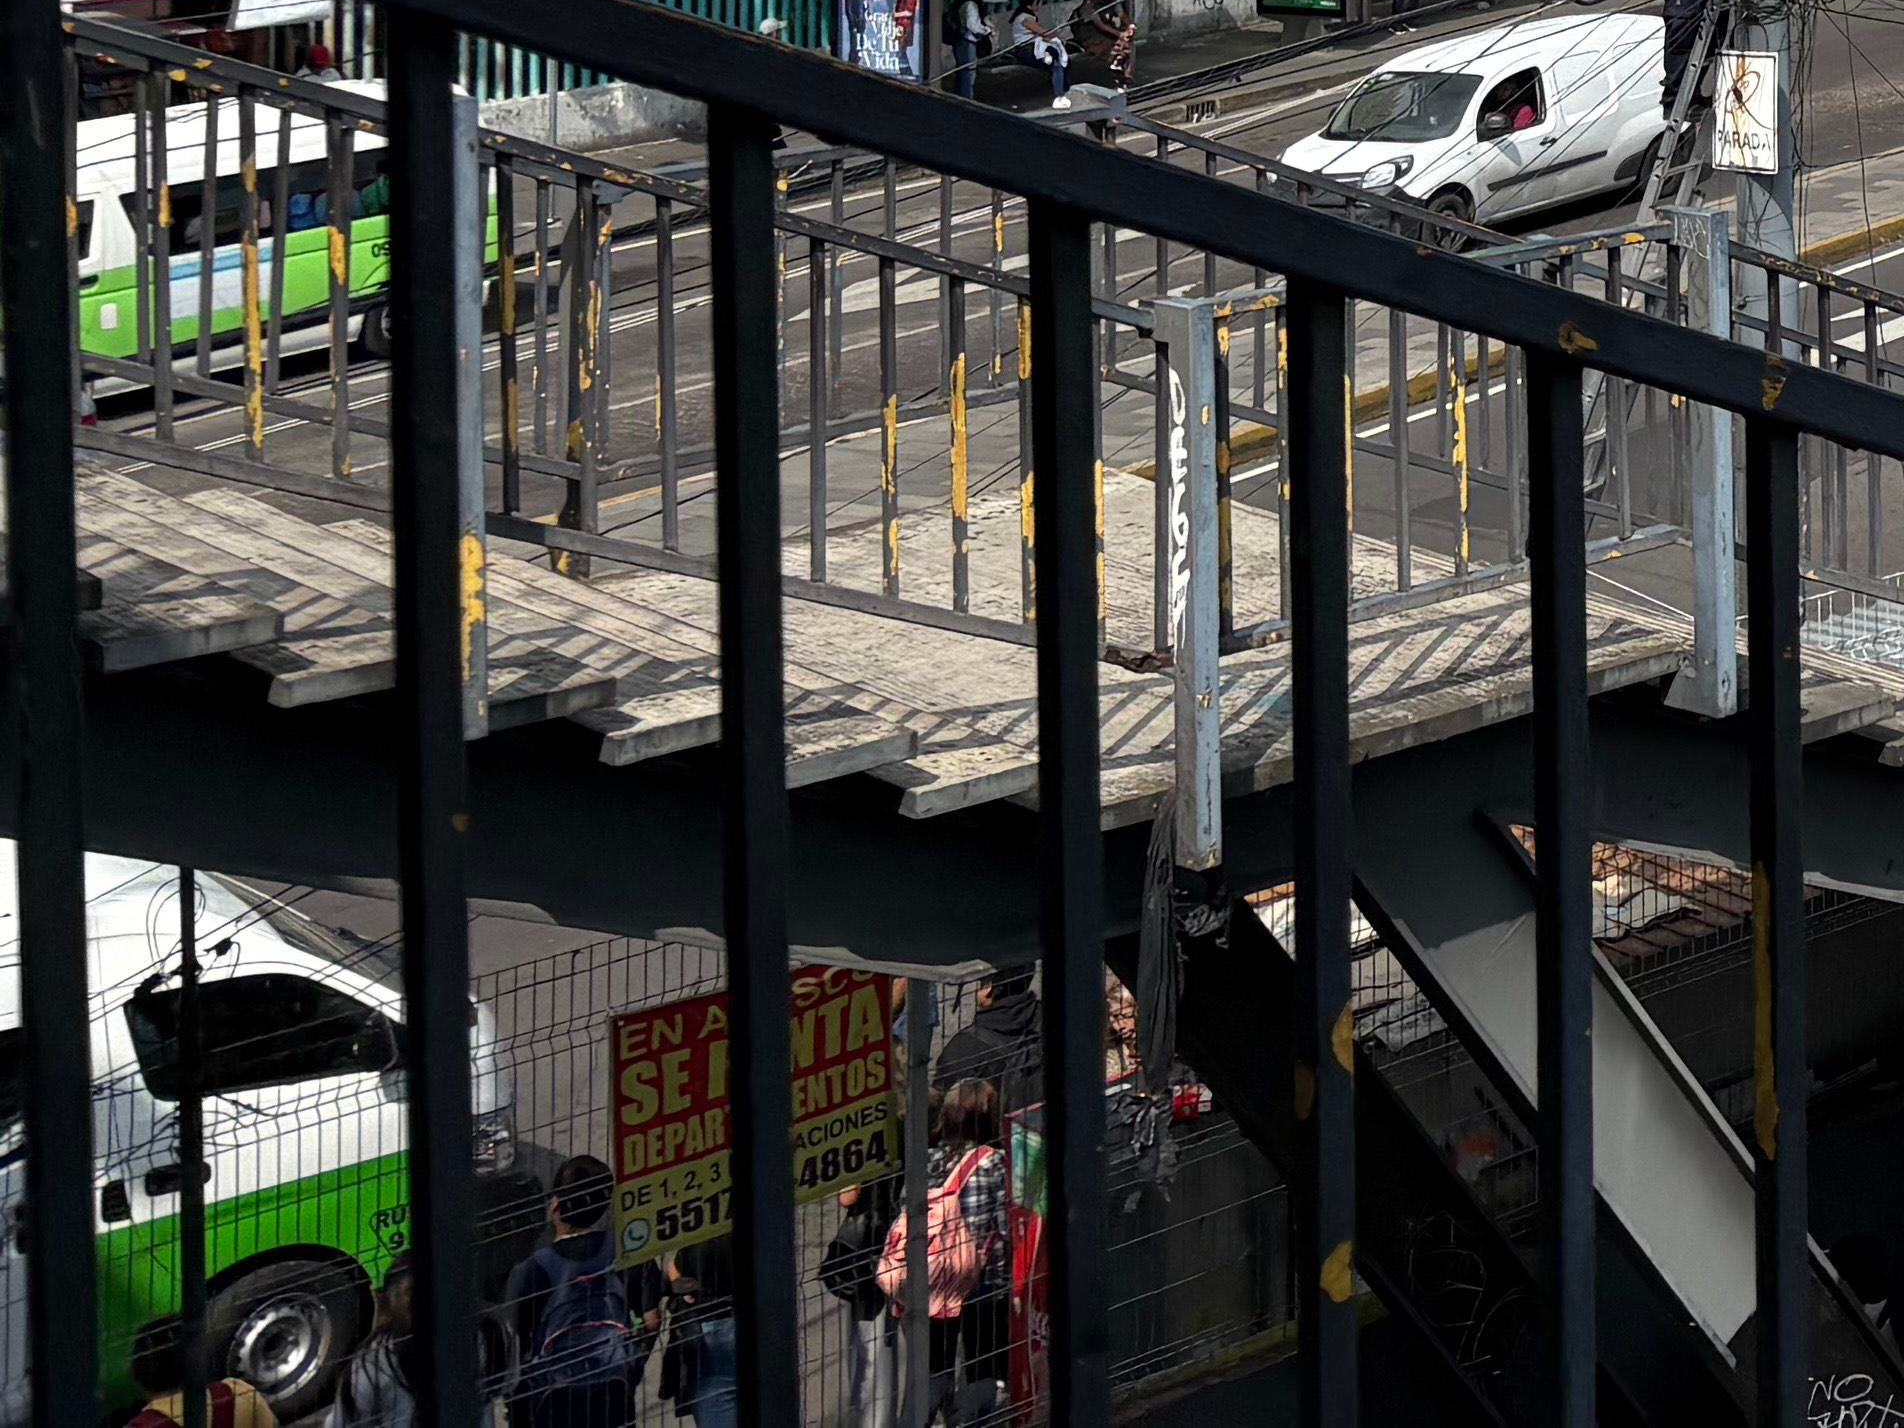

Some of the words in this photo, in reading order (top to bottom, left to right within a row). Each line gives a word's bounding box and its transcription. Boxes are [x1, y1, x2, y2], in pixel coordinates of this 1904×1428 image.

[619, 1014, 684, 1061] EN
[620, 1048, 692, 1126] SE
[621, 1184, 652, 1212] DE
[711, 1162, 721, 1183] 3
